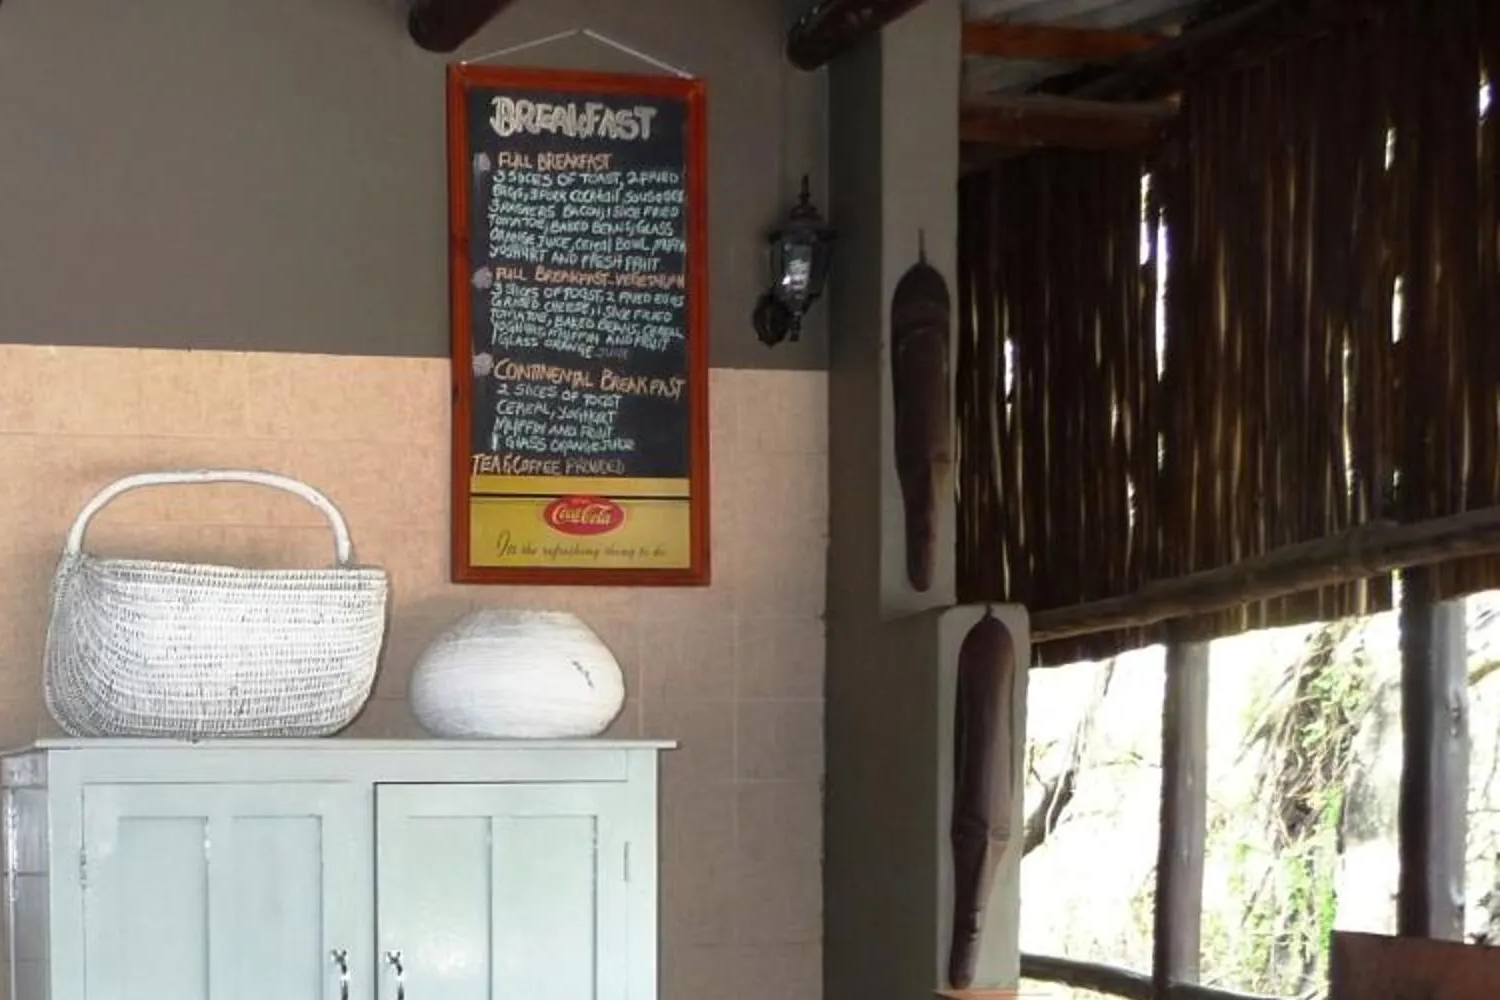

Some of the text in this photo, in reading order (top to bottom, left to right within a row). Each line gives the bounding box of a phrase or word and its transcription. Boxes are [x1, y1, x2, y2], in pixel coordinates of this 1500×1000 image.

[490, 96, 658, 140] BREAKFAST
[499, 152, 612, 170] FULL BREAKFAST
[557, 172, 577, 186] OF
[551, 252, 578, 266] AND
[496, 267, 527, 281] FULL
[547, 424, 577, 437] AND
